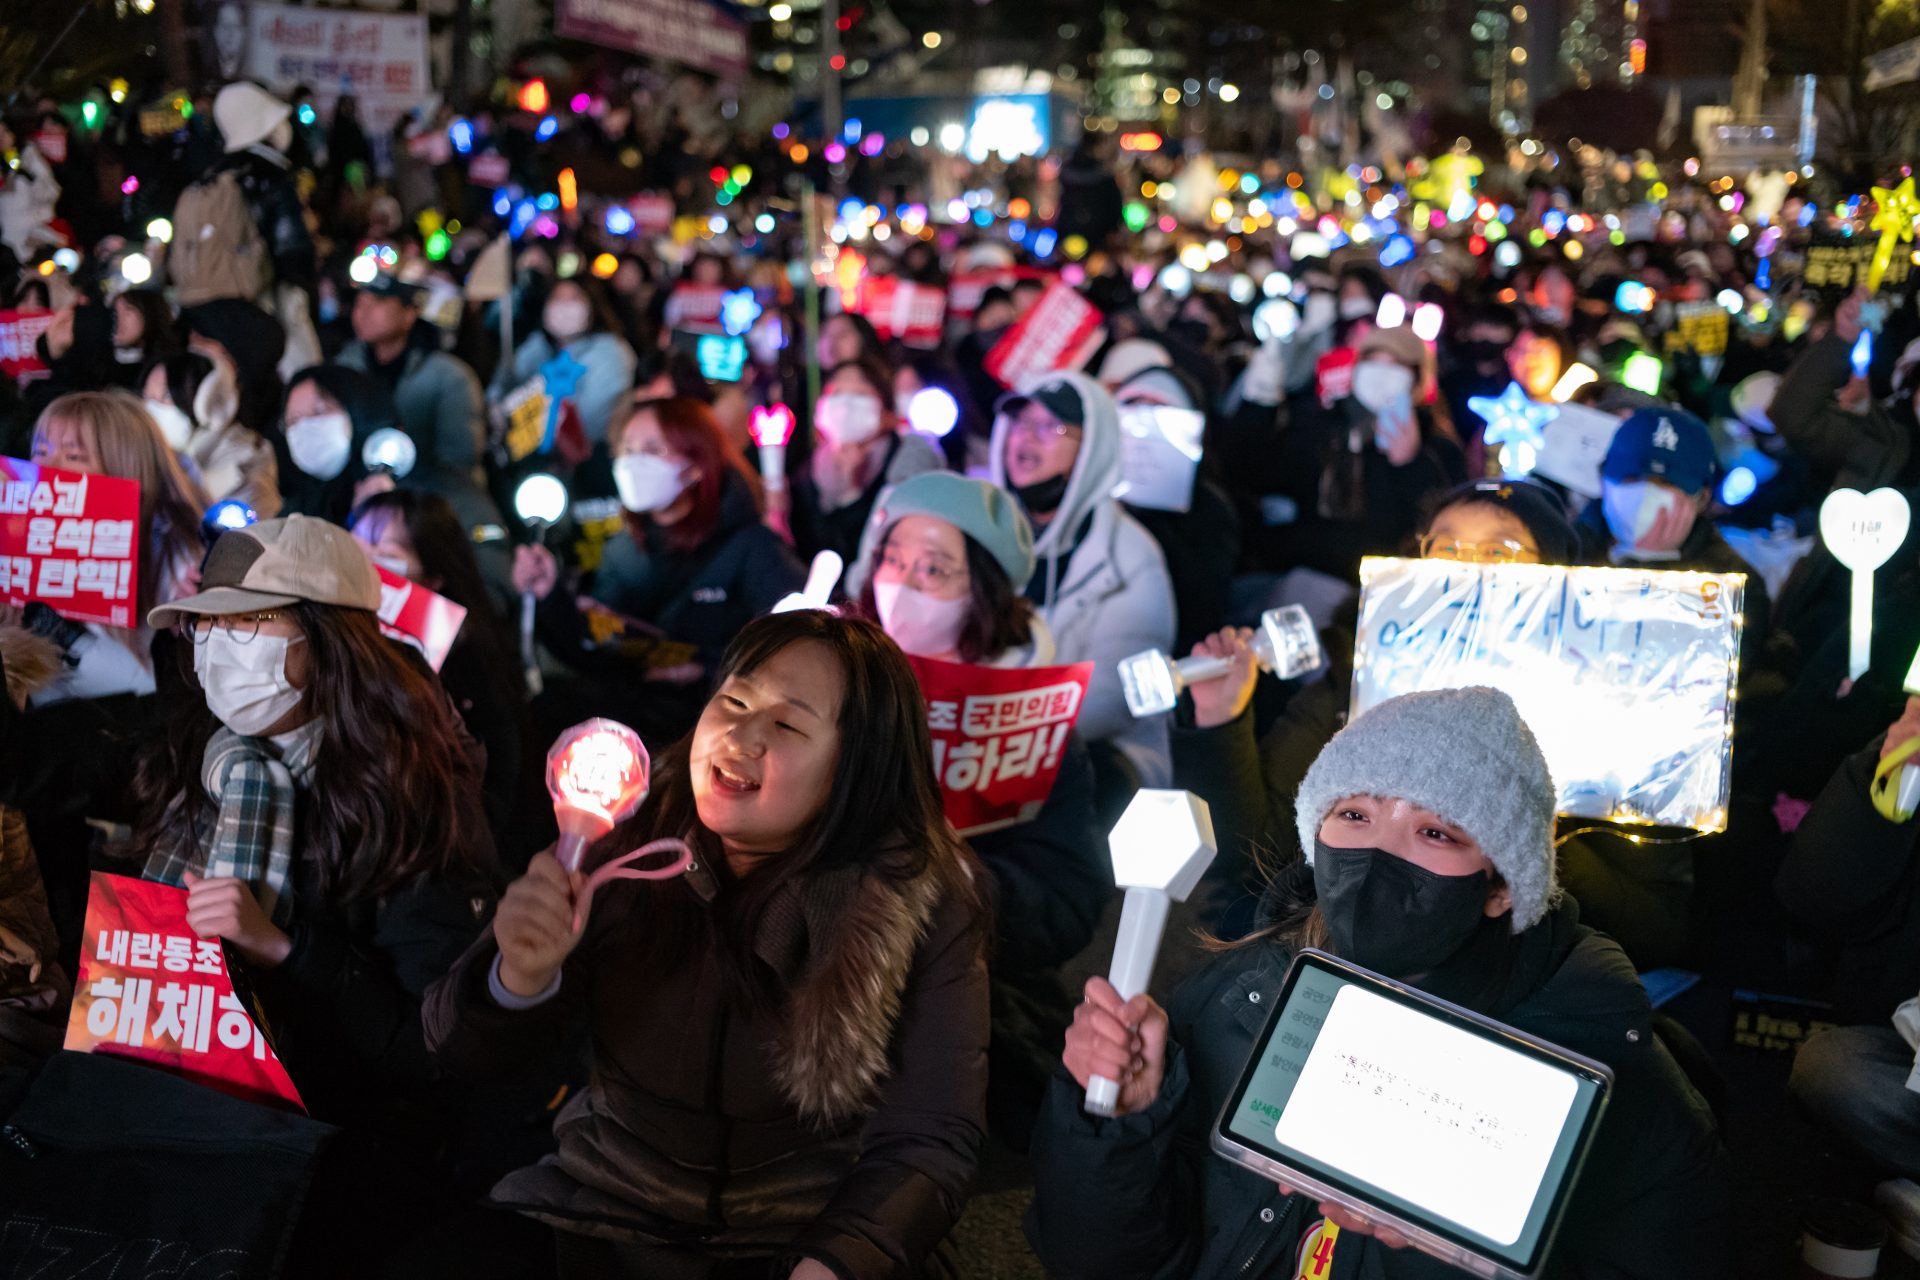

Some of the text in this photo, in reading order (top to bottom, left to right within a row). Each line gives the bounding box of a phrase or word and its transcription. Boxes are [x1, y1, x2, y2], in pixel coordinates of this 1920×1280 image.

[26, 517, 133, 558] 윤석열
[36, 559, 132, 600] 탄핵!
[969, 688, 1073, 730] 국민의힘
[96, 930, 223, 976] 내란동조
[87, 977, 279, 1061] 해체하
